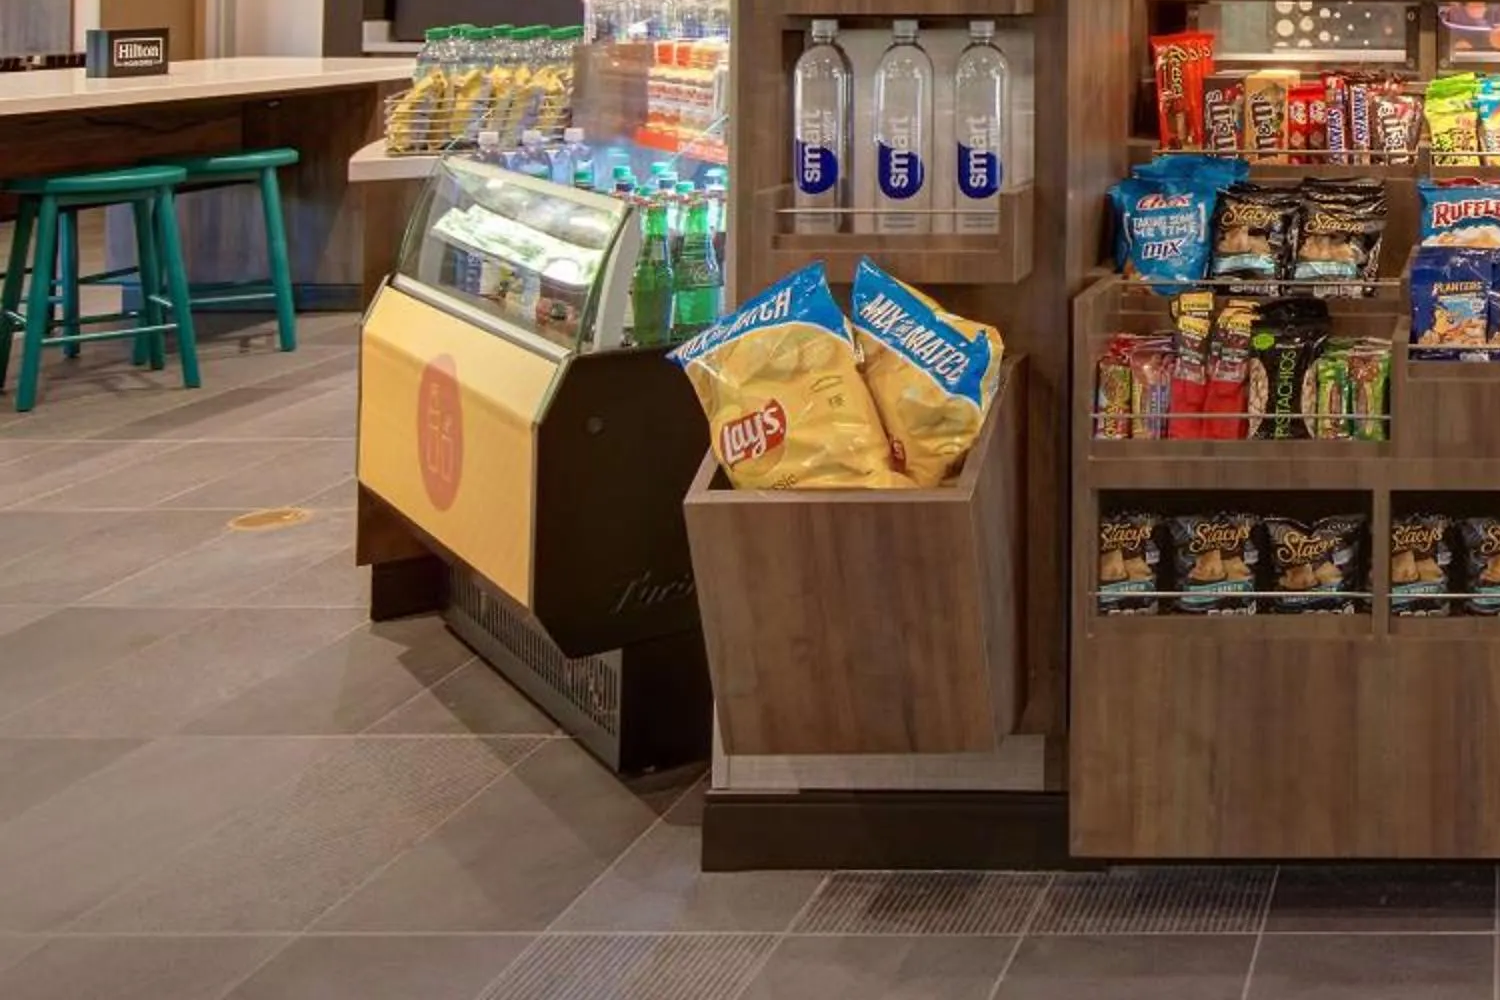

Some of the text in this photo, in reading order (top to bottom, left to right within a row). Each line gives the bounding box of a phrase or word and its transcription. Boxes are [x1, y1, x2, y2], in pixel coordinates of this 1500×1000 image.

[118, 43, 159, 59] Hilton
[804, 109, 822, 184] smart
[889, 116, 910, 189] smart
[966, 116, 988, 189] smart
[860, 292, 908, 334] MIX
[1275, 351, 1296, 438] PISTACHIOS
[725, 406, 784, 464] Lay's
